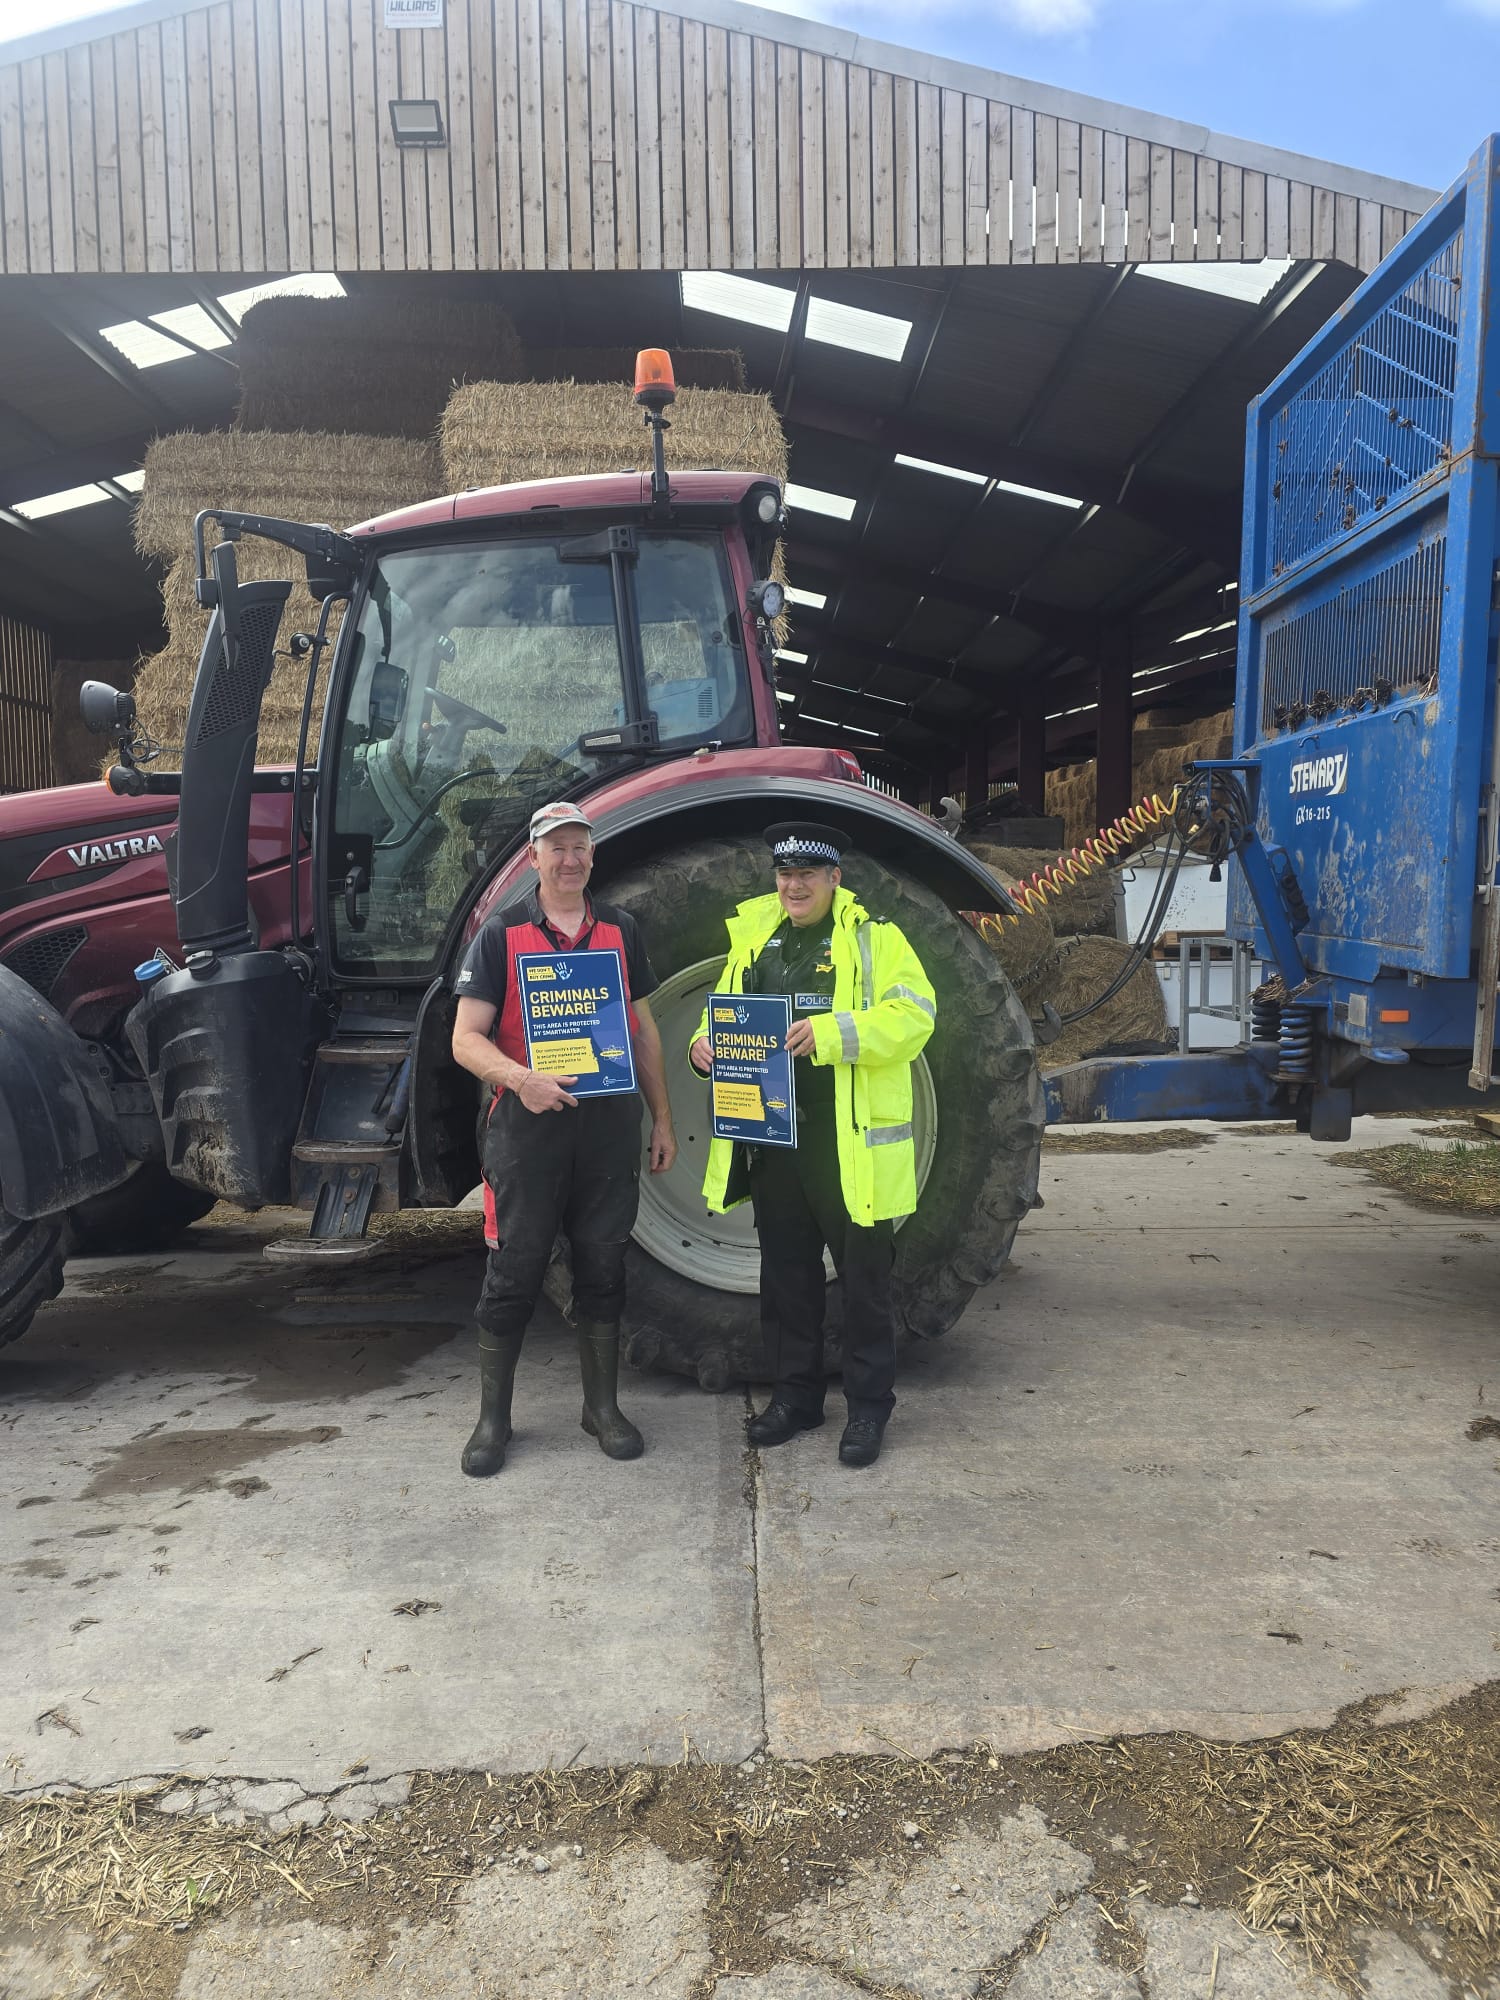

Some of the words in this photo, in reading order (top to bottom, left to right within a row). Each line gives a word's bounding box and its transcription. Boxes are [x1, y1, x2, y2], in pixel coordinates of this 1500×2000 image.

[390, 0, 436, 12] WILLIAMS
[1289, 751, 1348, 796] STEWART
[67, 834, 164, 867] VALTRA
[529, 987, 609, 1005] CRIMINALS
[531, 1001, 597, 1018] BEWARE!
[569, 1019, 601, 1027] PROTECTED
[542, 1027, 581, 1036] SMARTWATER
[715, 1032, 778, 1049] CRIMINALS
[715, 1046, 766, 1062] BEWARE!
[743, 1066, 769, 1074] PROTECTED
